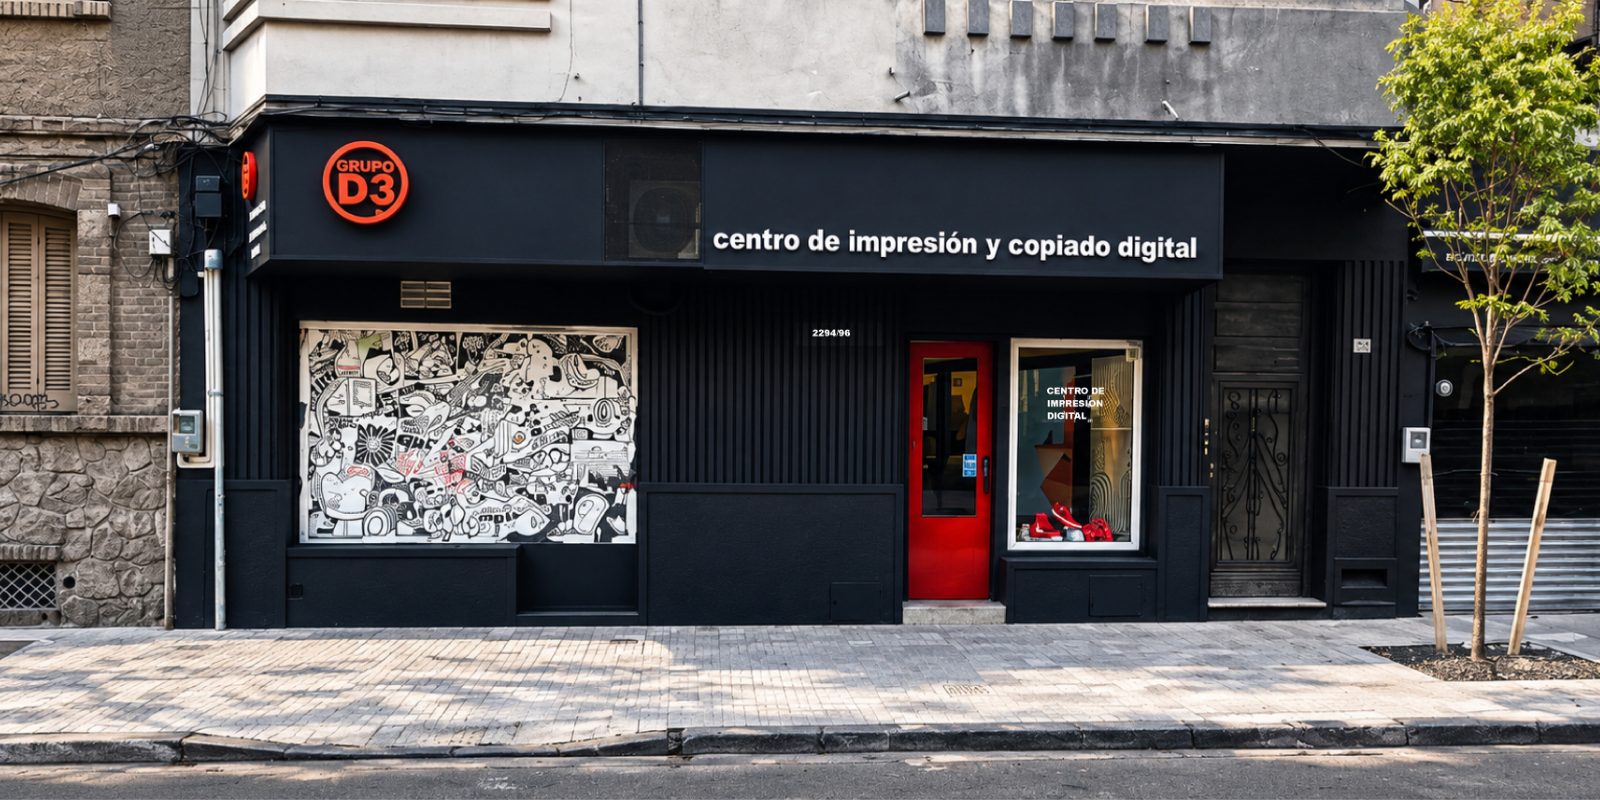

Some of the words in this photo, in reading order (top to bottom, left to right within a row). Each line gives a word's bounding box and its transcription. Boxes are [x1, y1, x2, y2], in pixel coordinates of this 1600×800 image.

[336, 160, 395, 173] GRUPO
[338, 173, 395, 206] D3
[713, 228, 800, 251] centro
[808, 228, 841, 252] de
[849, 230, 978, 257] impresión
[985, 238, 1001, 259] y
[1008, 234, 1111, 261] copiado
[1117, 236, 1198, 263] digital
[1046, 387, 1089, 395] CENTRO
[1091, 387, 1105, 395] DE
[1047, 411, 1087, 420] DIGITAL
